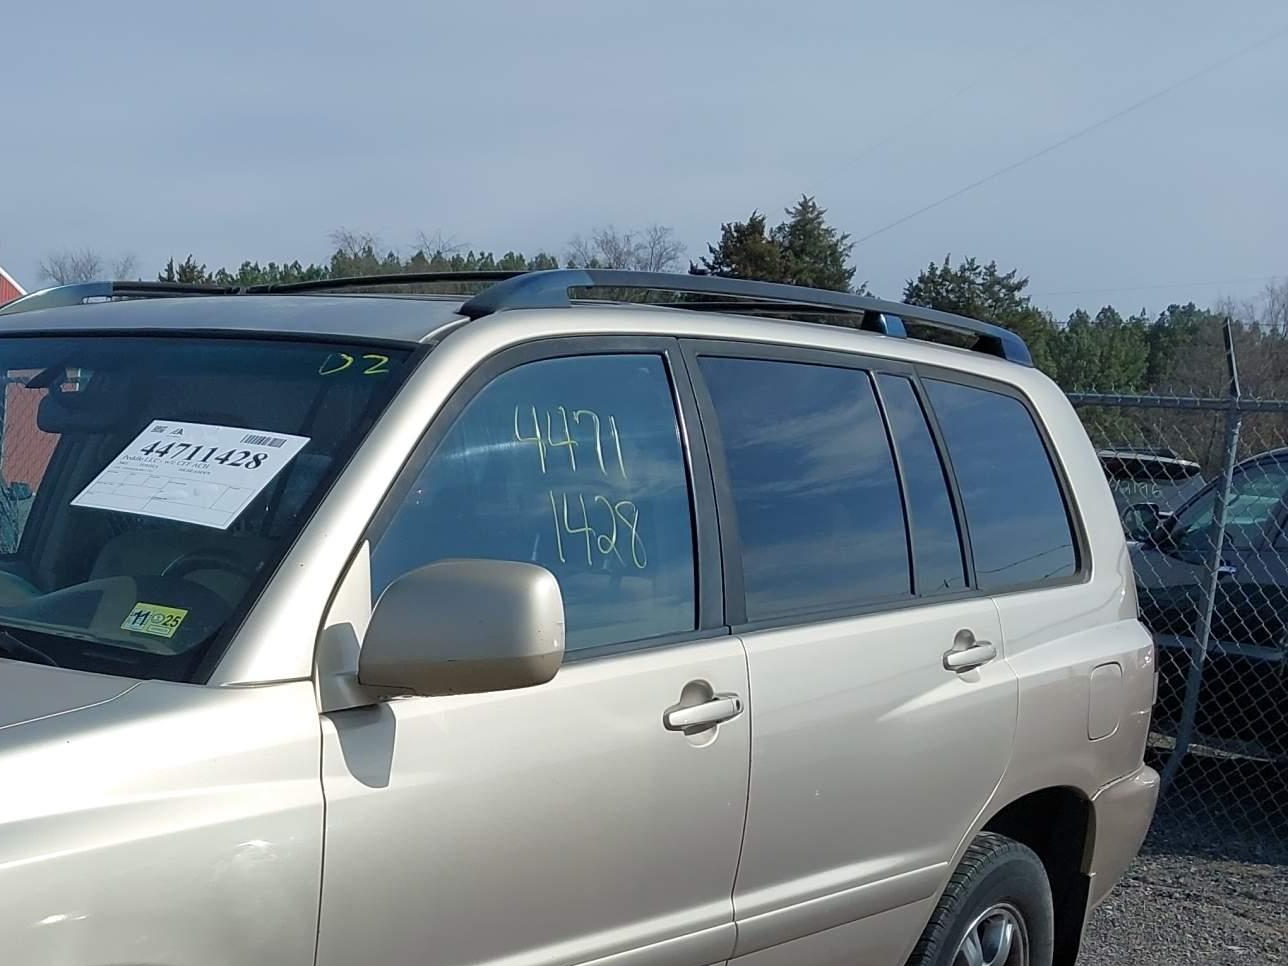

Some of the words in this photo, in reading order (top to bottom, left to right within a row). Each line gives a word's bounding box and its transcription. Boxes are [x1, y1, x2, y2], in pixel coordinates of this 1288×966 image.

[140, 440, 269, 470] 44711428
[515, 405, 627, 480] 4471
[550, 490, 647, 568] 1428
[131, 609, 151, 626] 11
[162, 614, 182, 628] 25
